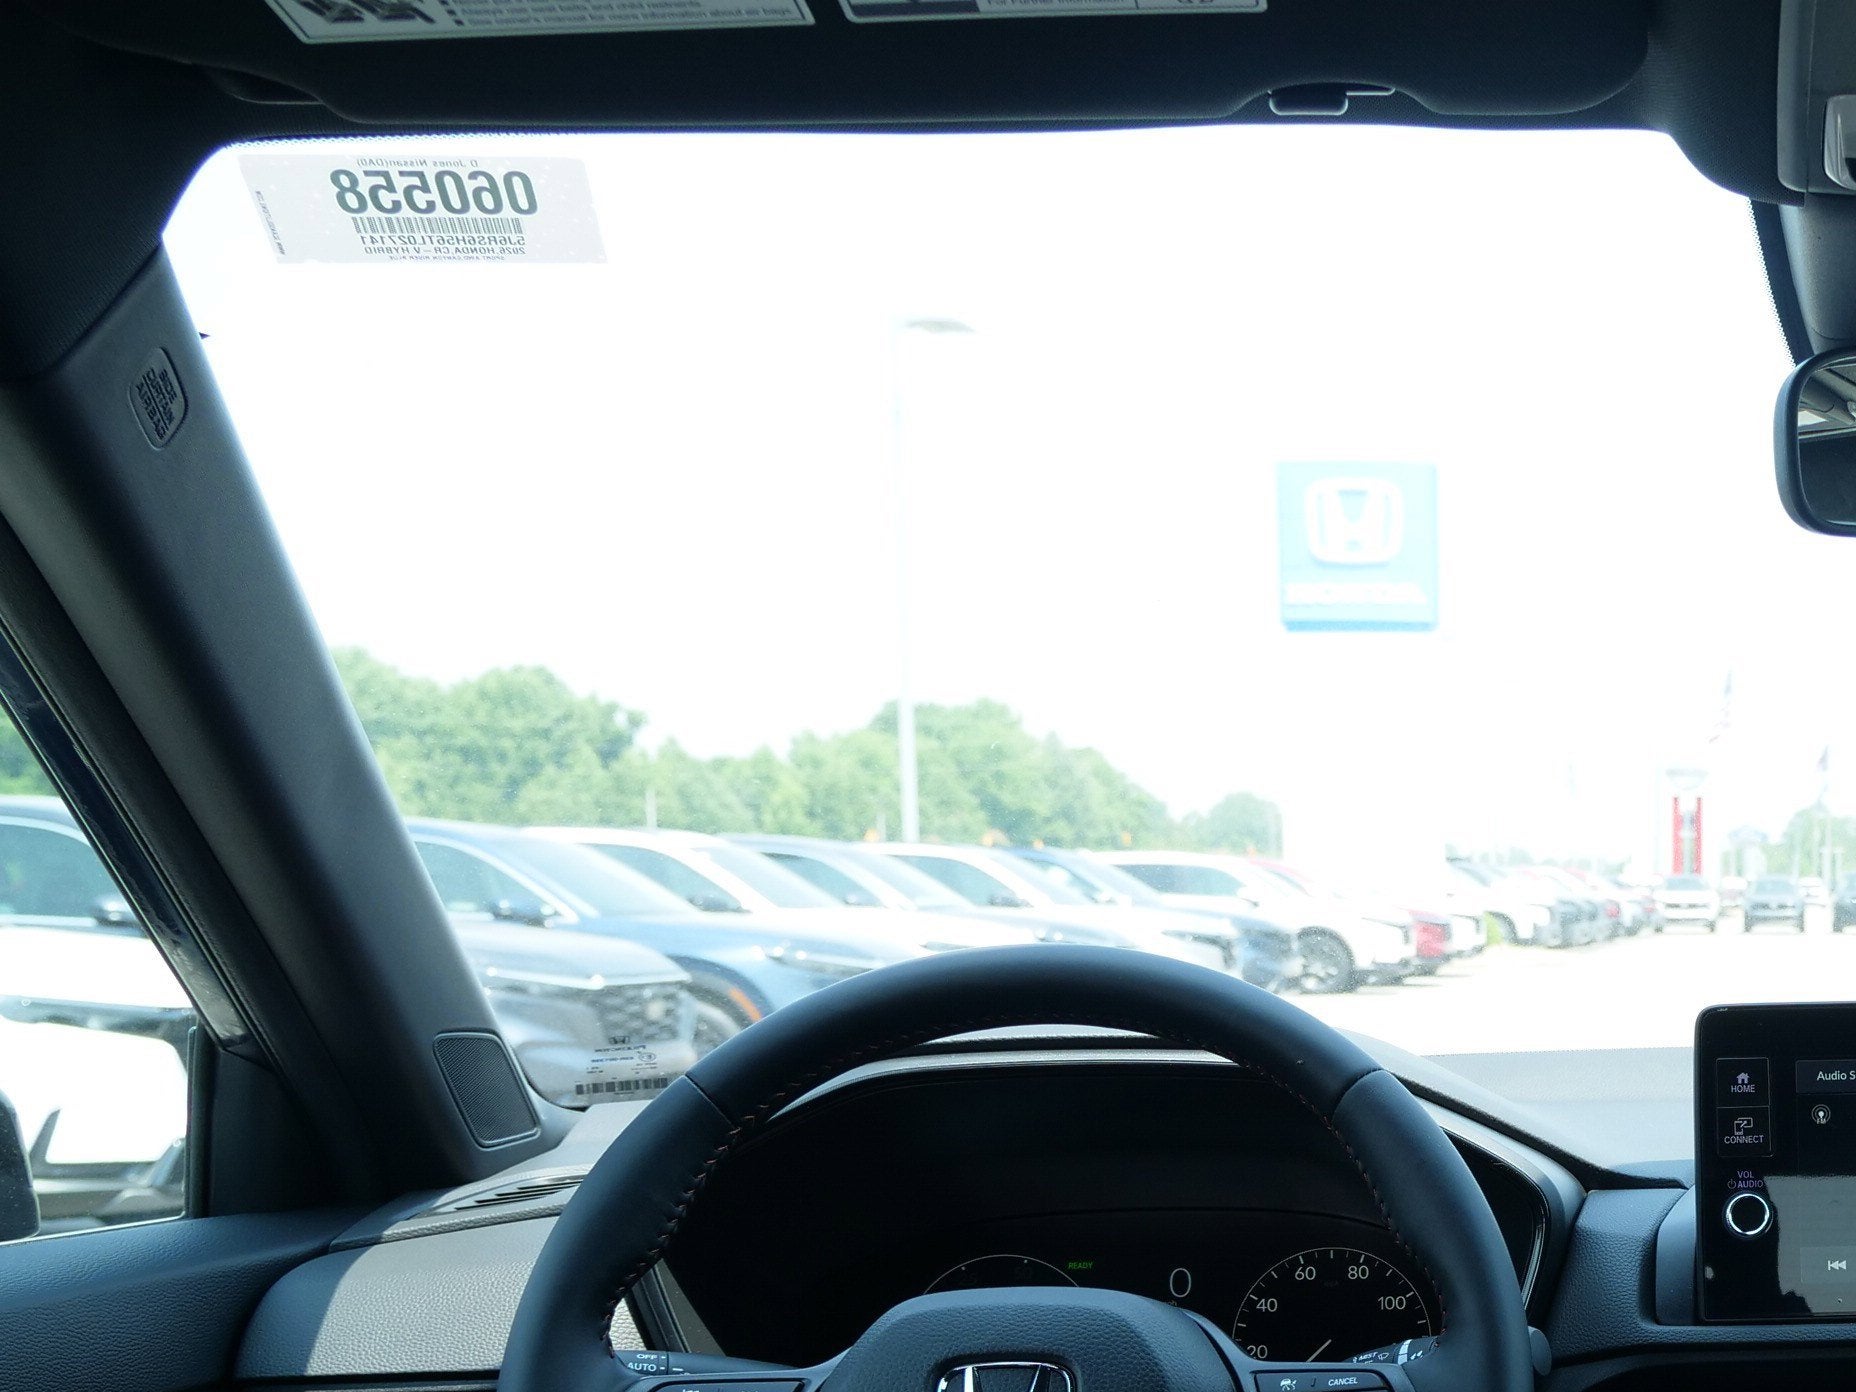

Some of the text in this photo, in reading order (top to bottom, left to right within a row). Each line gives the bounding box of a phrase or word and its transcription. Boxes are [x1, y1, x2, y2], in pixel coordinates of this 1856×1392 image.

[1816, 1070, 1846, 1081] Audio
[1730, 1084, 1755, 1093] HOME
[1724, 1134, 1764, 1144] CONNECT
[1737, 1170, 1755, 1179] VOL
[1737, 1180, 1764, 1188] AUDIO
[1066, 1260, 1096, 1270] READY
[1294, 1266, 1316, 1281] 60
[1348, 1266, 1370, 1280] 80
[1169, 1267, 1192, 1298] 0
[1256, 1298, 1278, 1312] 40
[1378, 1296, 1406, 1310] 100
[1246, 1344, 1268, 1360] 20
[627, 1362, 657, 1372] AUTO
[1328, 1377, 1358, 1386] CANCEL
